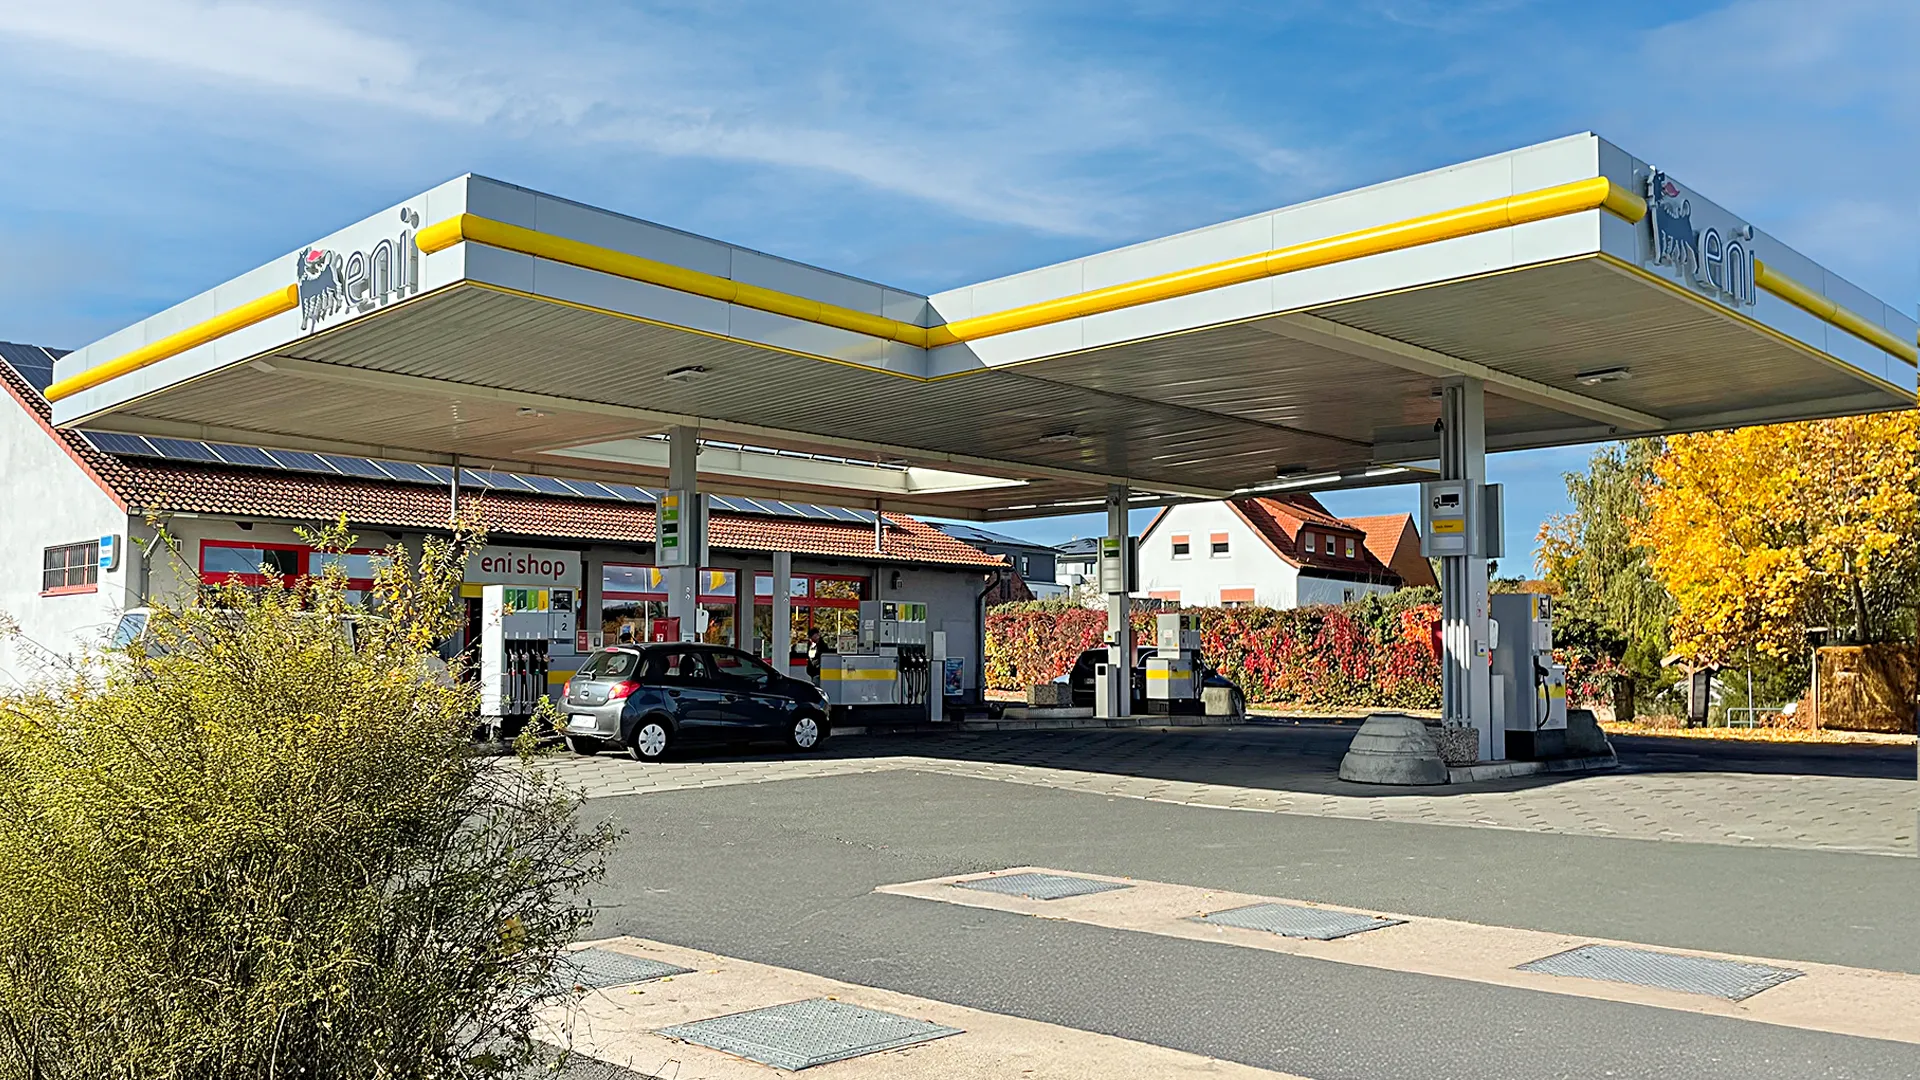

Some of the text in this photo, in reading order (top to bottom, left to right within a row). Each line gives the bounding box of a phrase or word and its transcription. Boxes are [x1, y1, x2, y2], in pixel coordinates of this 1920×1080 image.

[344, 206, 414, 308] eni
[1701, 224, 1757, 306] eni
[481, 552, 566, 581] eni shop
[561, 622, 568, 632] 2
